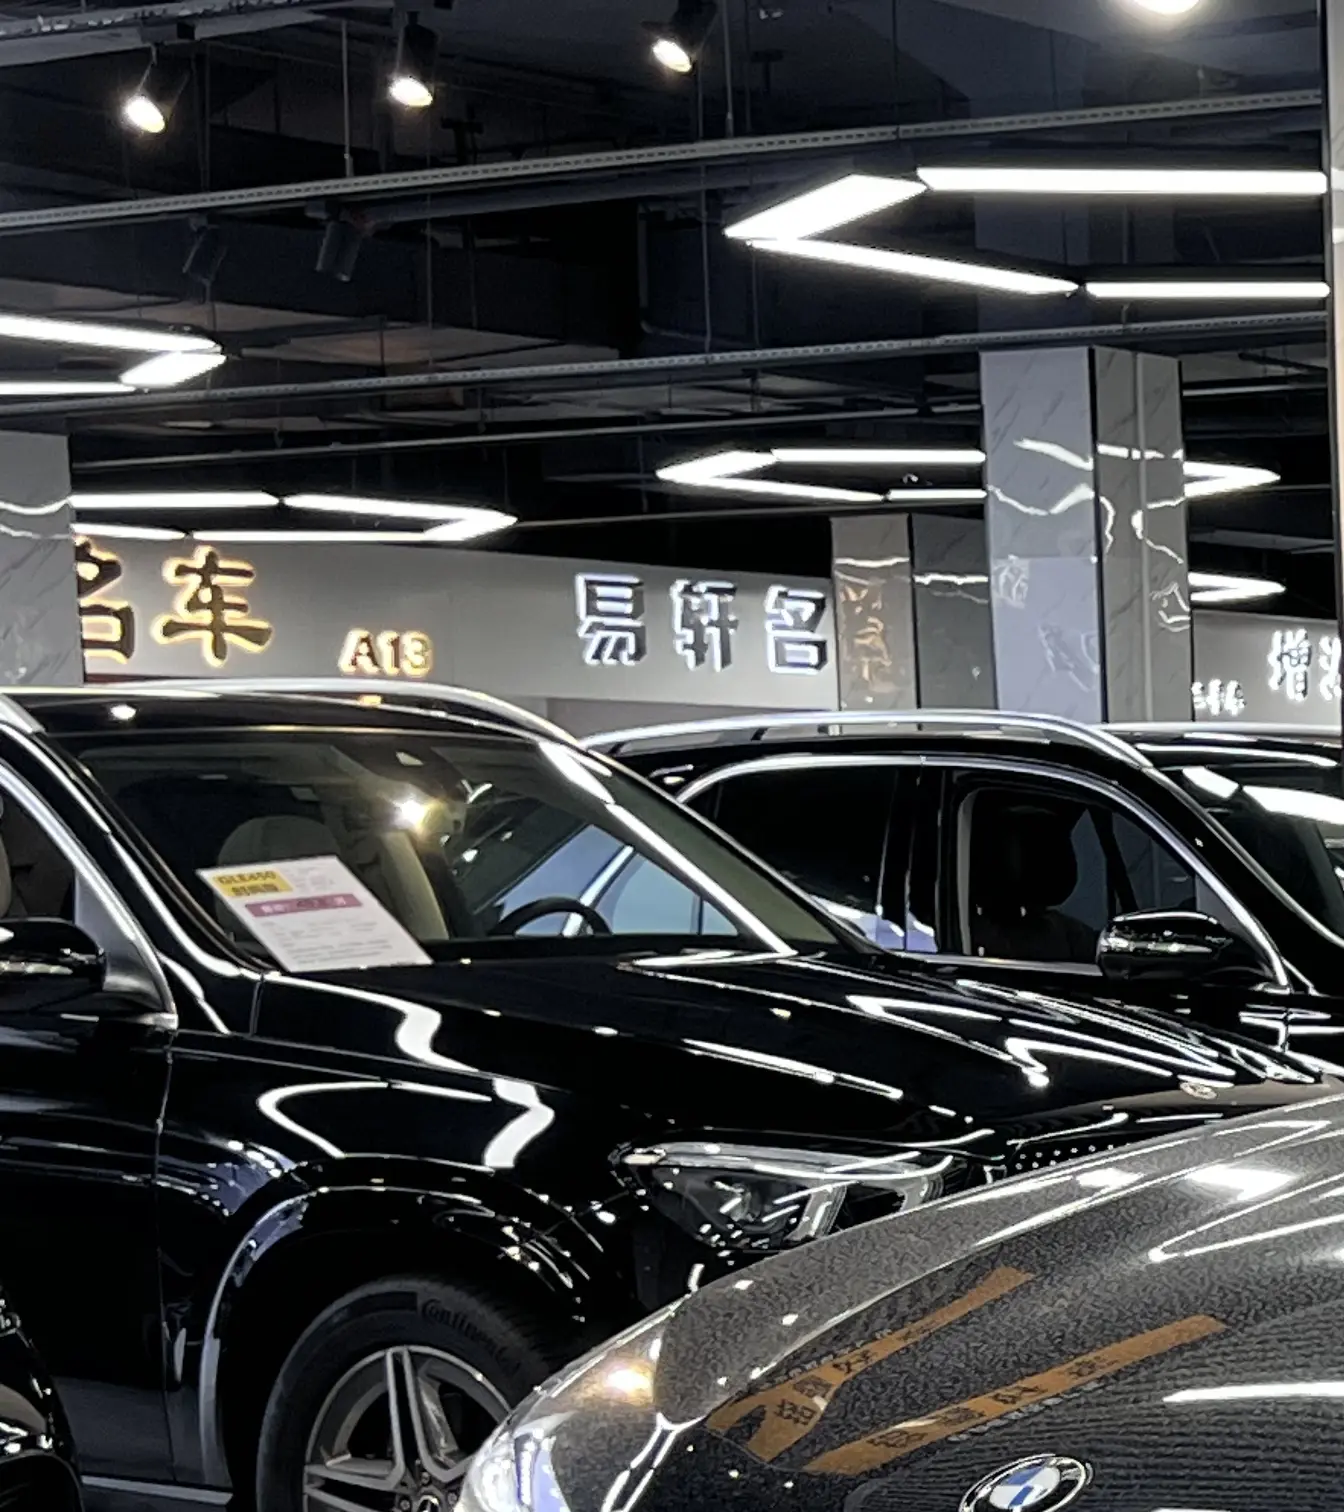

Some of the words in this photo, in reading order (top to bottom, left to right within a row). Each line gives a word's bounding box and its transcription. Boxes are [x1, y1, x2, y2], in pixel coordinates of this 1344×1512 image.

[338, 629, 434, 677] A13
[574, 572, 829, 675] 易轩名
